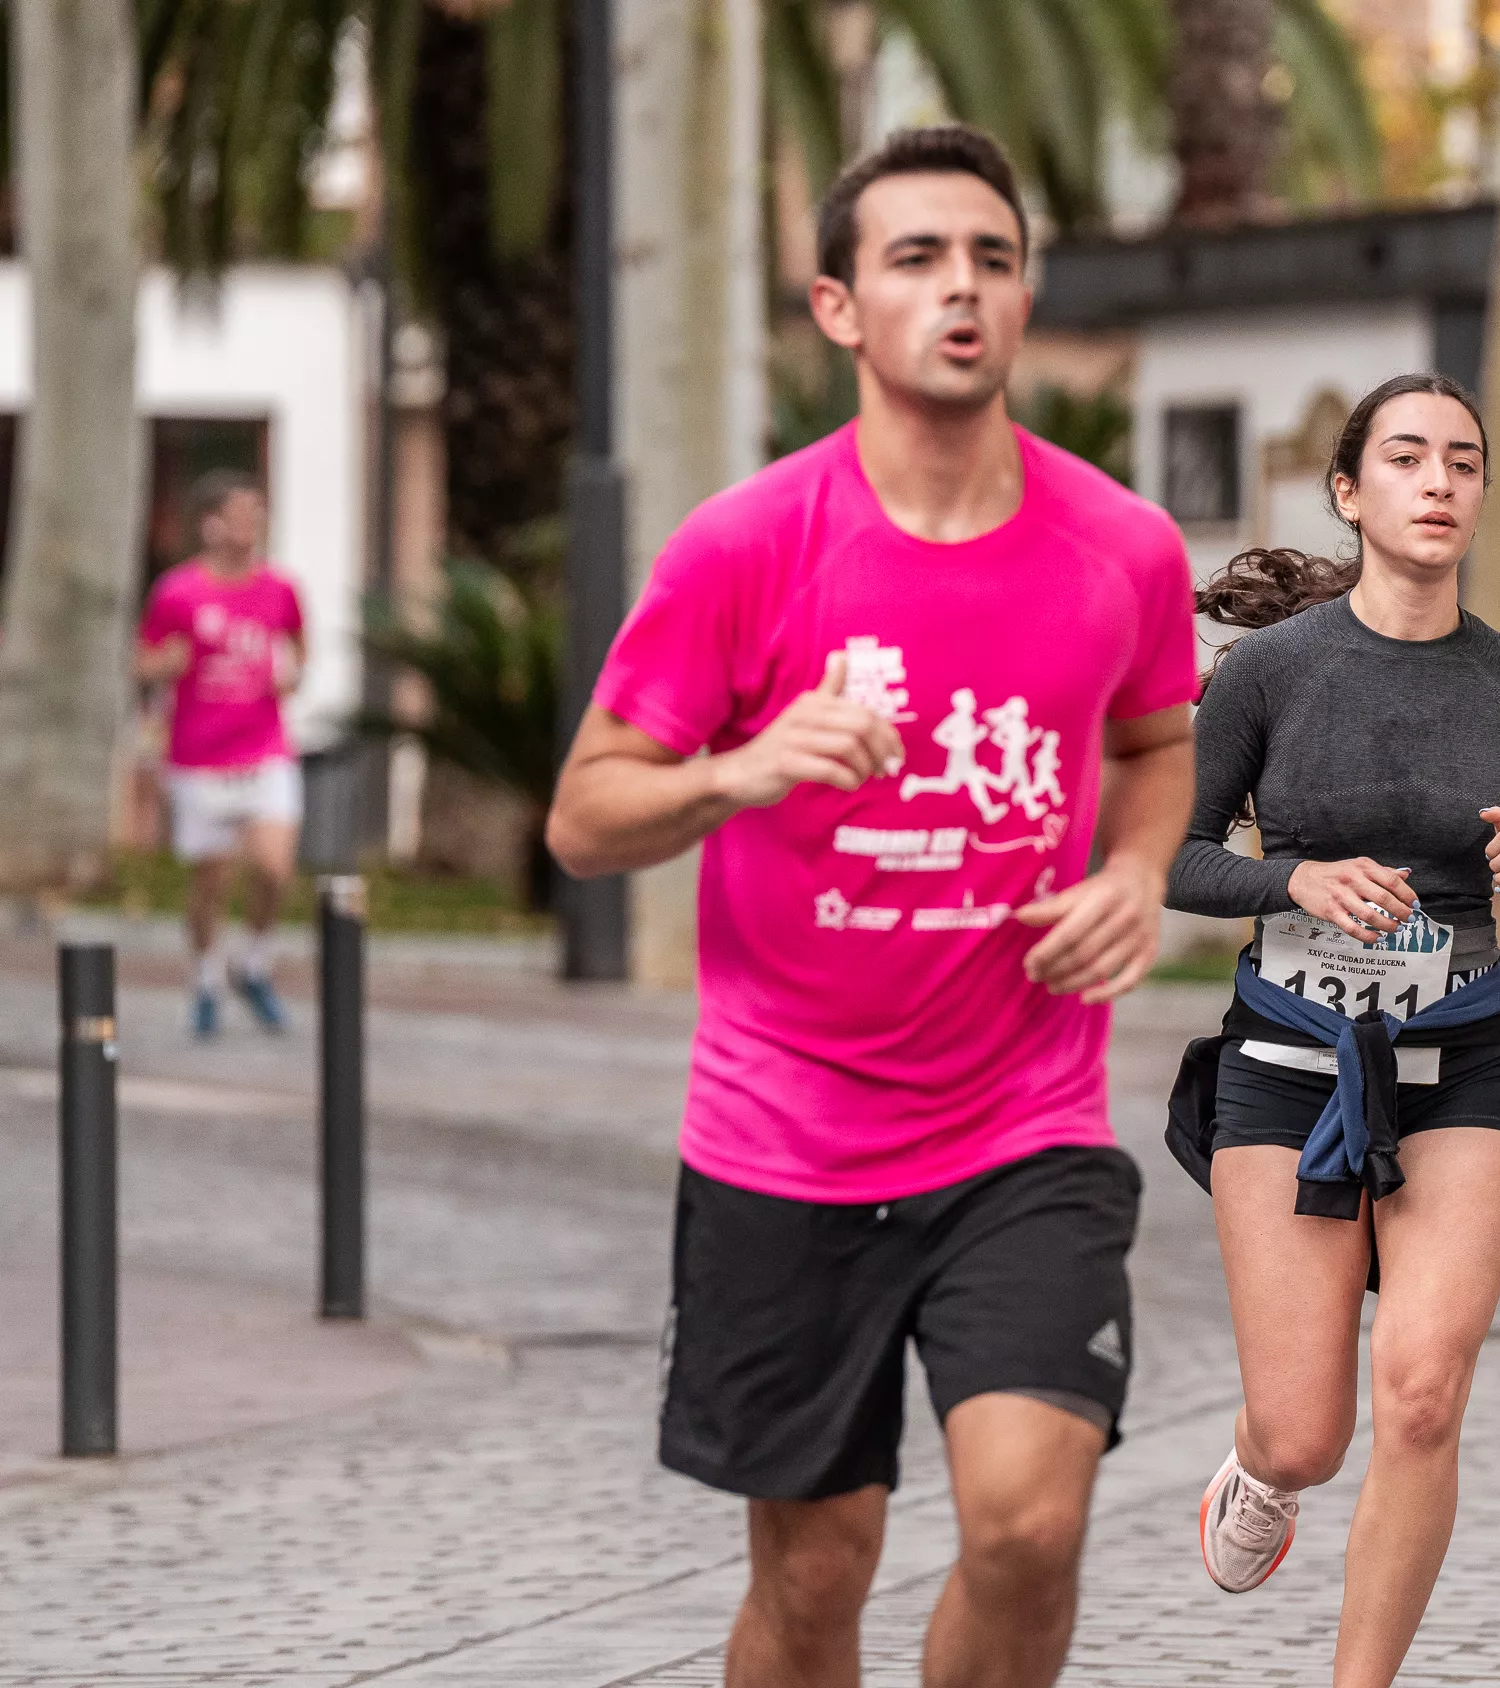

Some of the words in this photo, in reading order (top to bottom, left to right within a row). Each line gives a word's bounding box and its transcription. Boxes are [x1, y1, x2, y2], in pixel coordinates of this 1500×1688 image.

[1323, 951, 1336, 960] C.P.
[1337, 954, 1364, 965] CIUDAD
[1365, 957, 1376, 965] DE
[1377, 959, 1407, 967] LUCENA
[1320, 961, 1335, 970] POR
[1336, 964, 1347, 972] LA
[1348, 966, 1387, 976] IGUALDAD
[1284, 969, 1419, 1022] 1311
